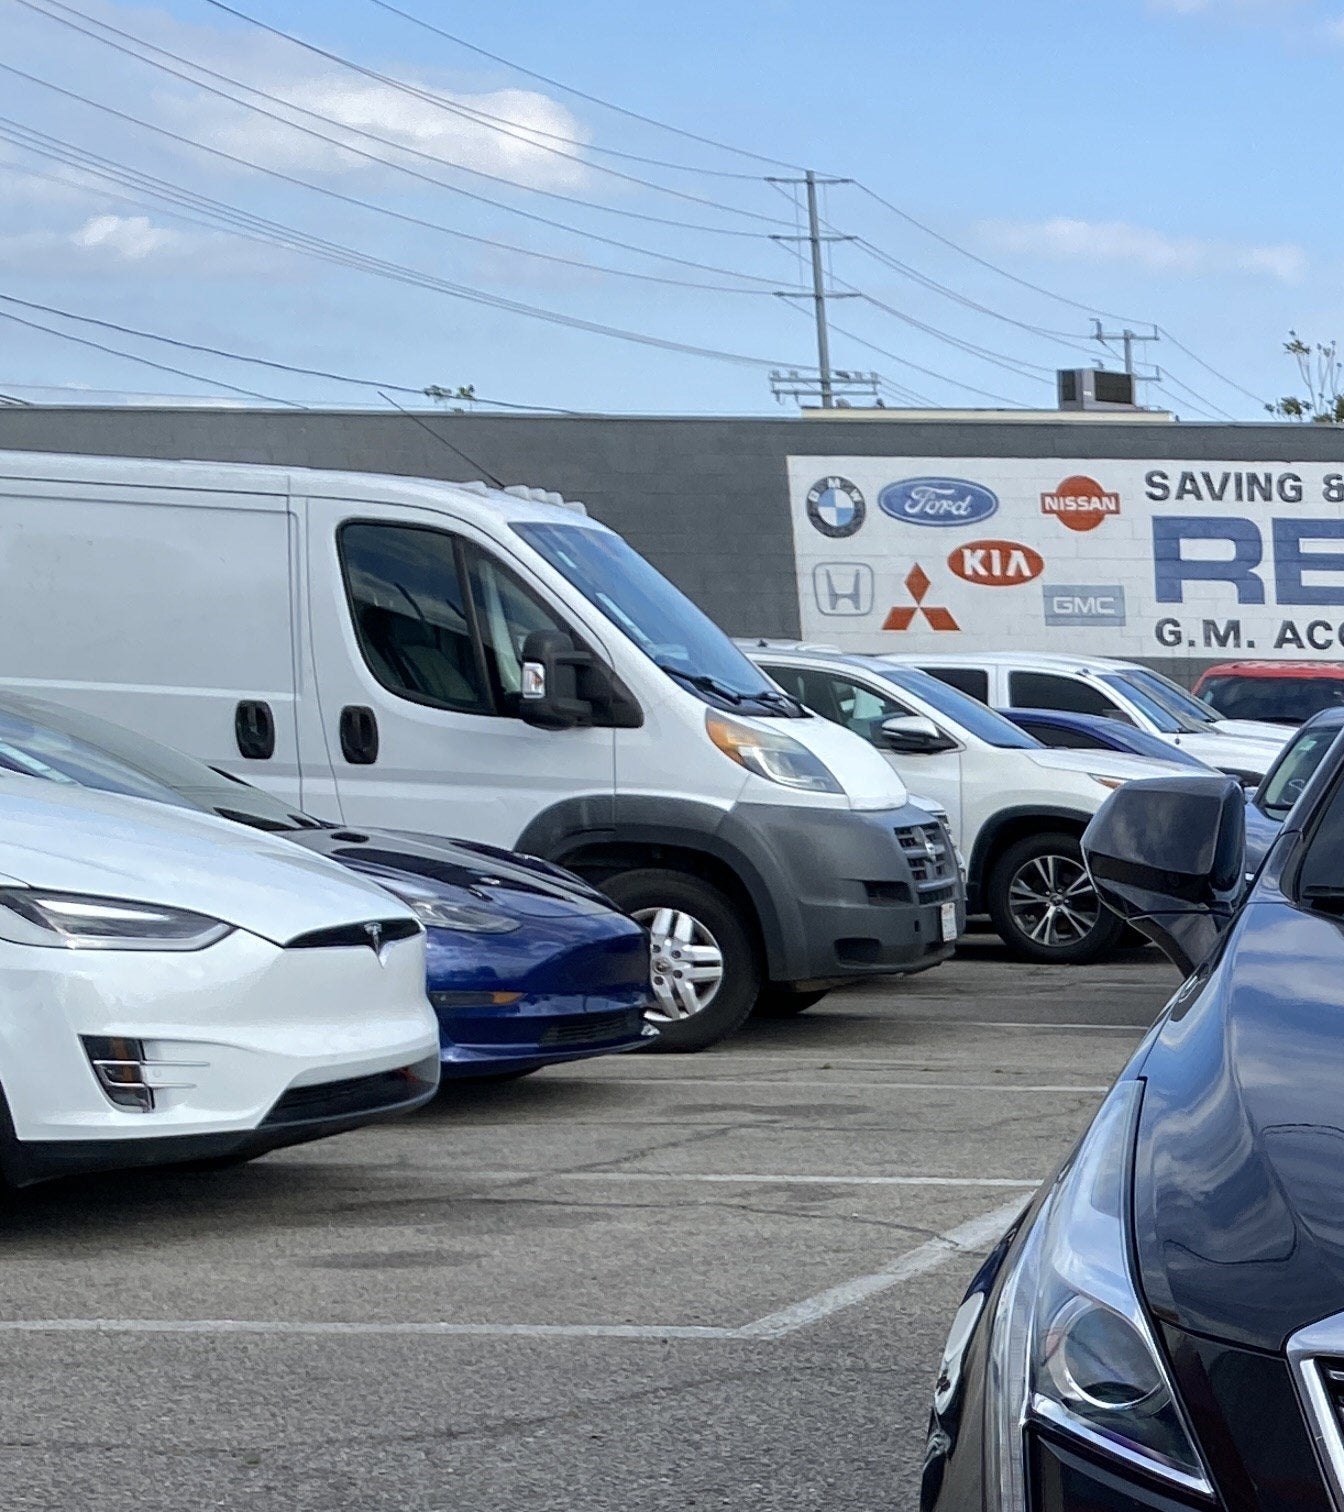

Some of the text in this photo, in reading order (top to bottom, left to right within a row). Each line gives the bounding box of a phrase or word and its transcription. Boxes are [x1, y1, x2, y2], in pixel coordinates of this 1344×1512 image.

[1144, 469, 1303, 502] SAVING
[904, 486, 972, 516] Ford
[1044, 496, 1118, 512] NISSAN
[961, 548, 1032, 577] KIA
[1053, 596, 1116, 614] GMC
[1155, 617, 1255, 649] G.M.
